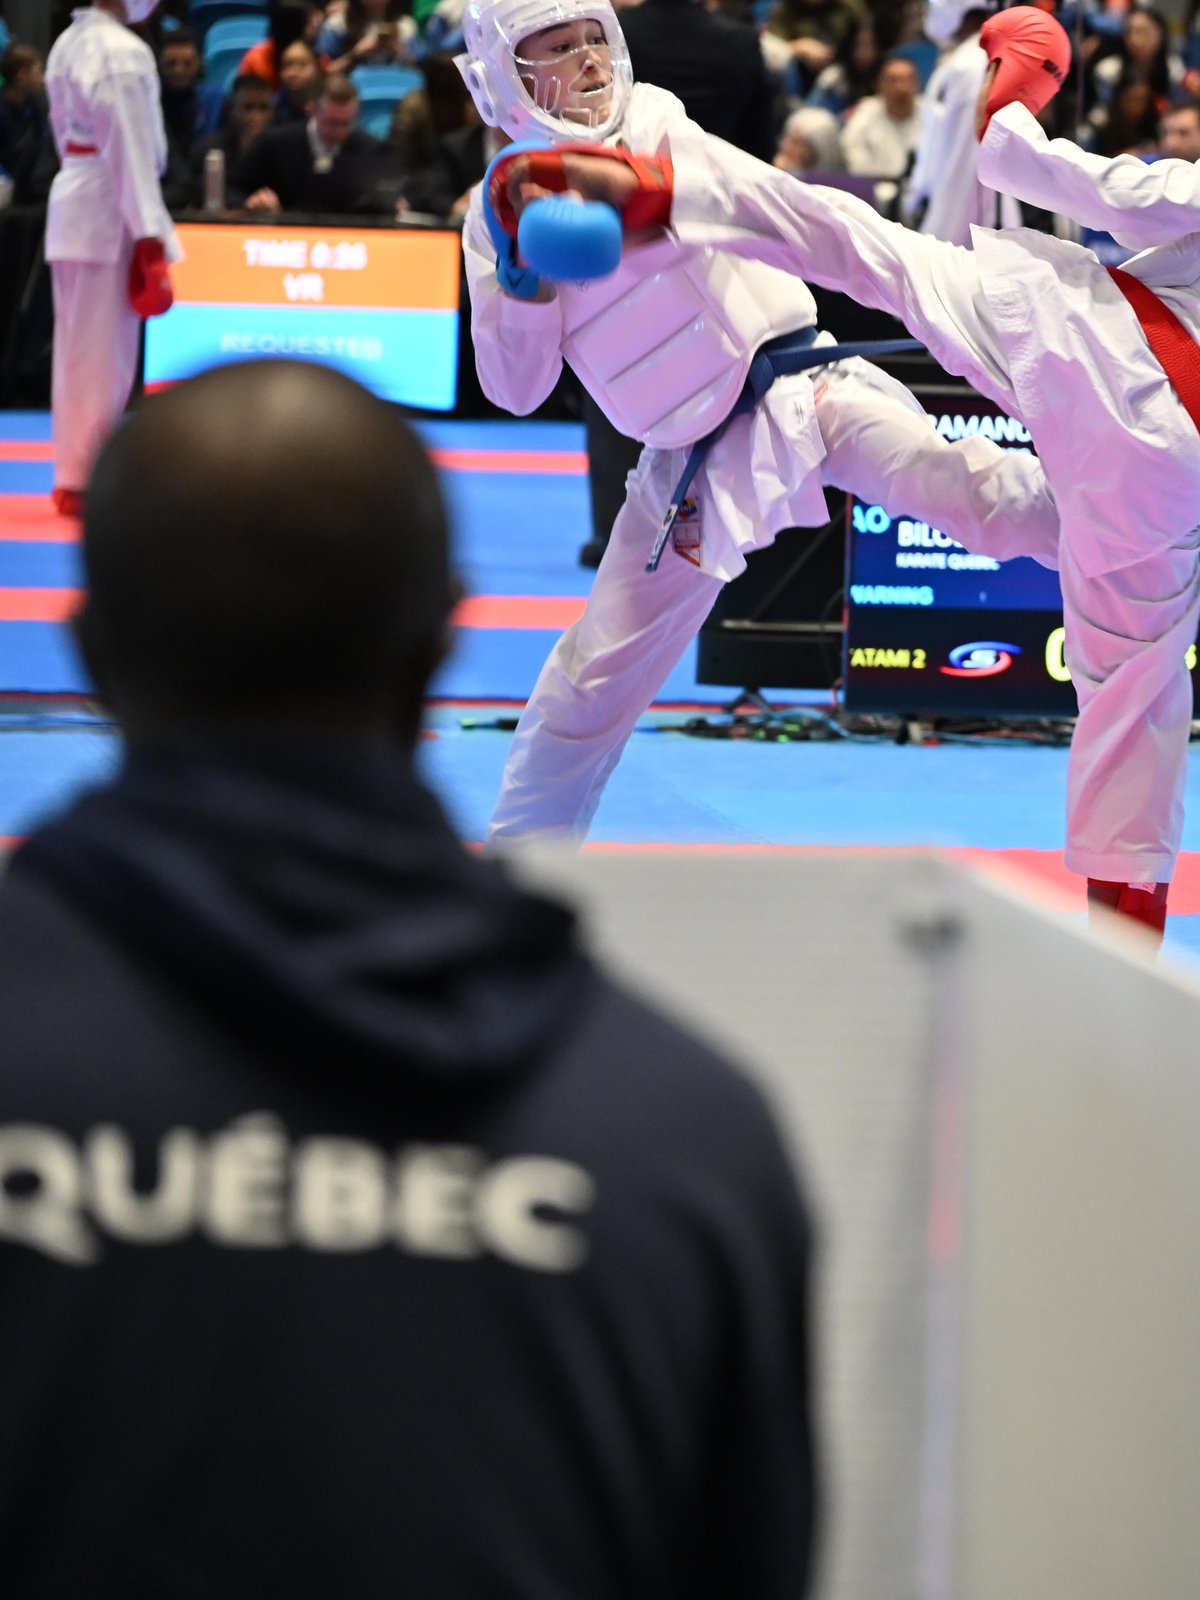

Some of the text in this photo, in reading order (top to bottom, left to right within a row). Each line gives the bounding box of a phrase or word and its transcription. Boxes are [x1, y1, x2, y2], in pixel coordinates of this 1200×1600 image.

[243, 239, 307, 268] TIME
[283, 273, 324, 301] VR
[221, 332, 383, 361] REQUESTED
[849, 648, 927, 669] ATAMI 2
[0, 1108, 594, 1275] QUÉBEC
